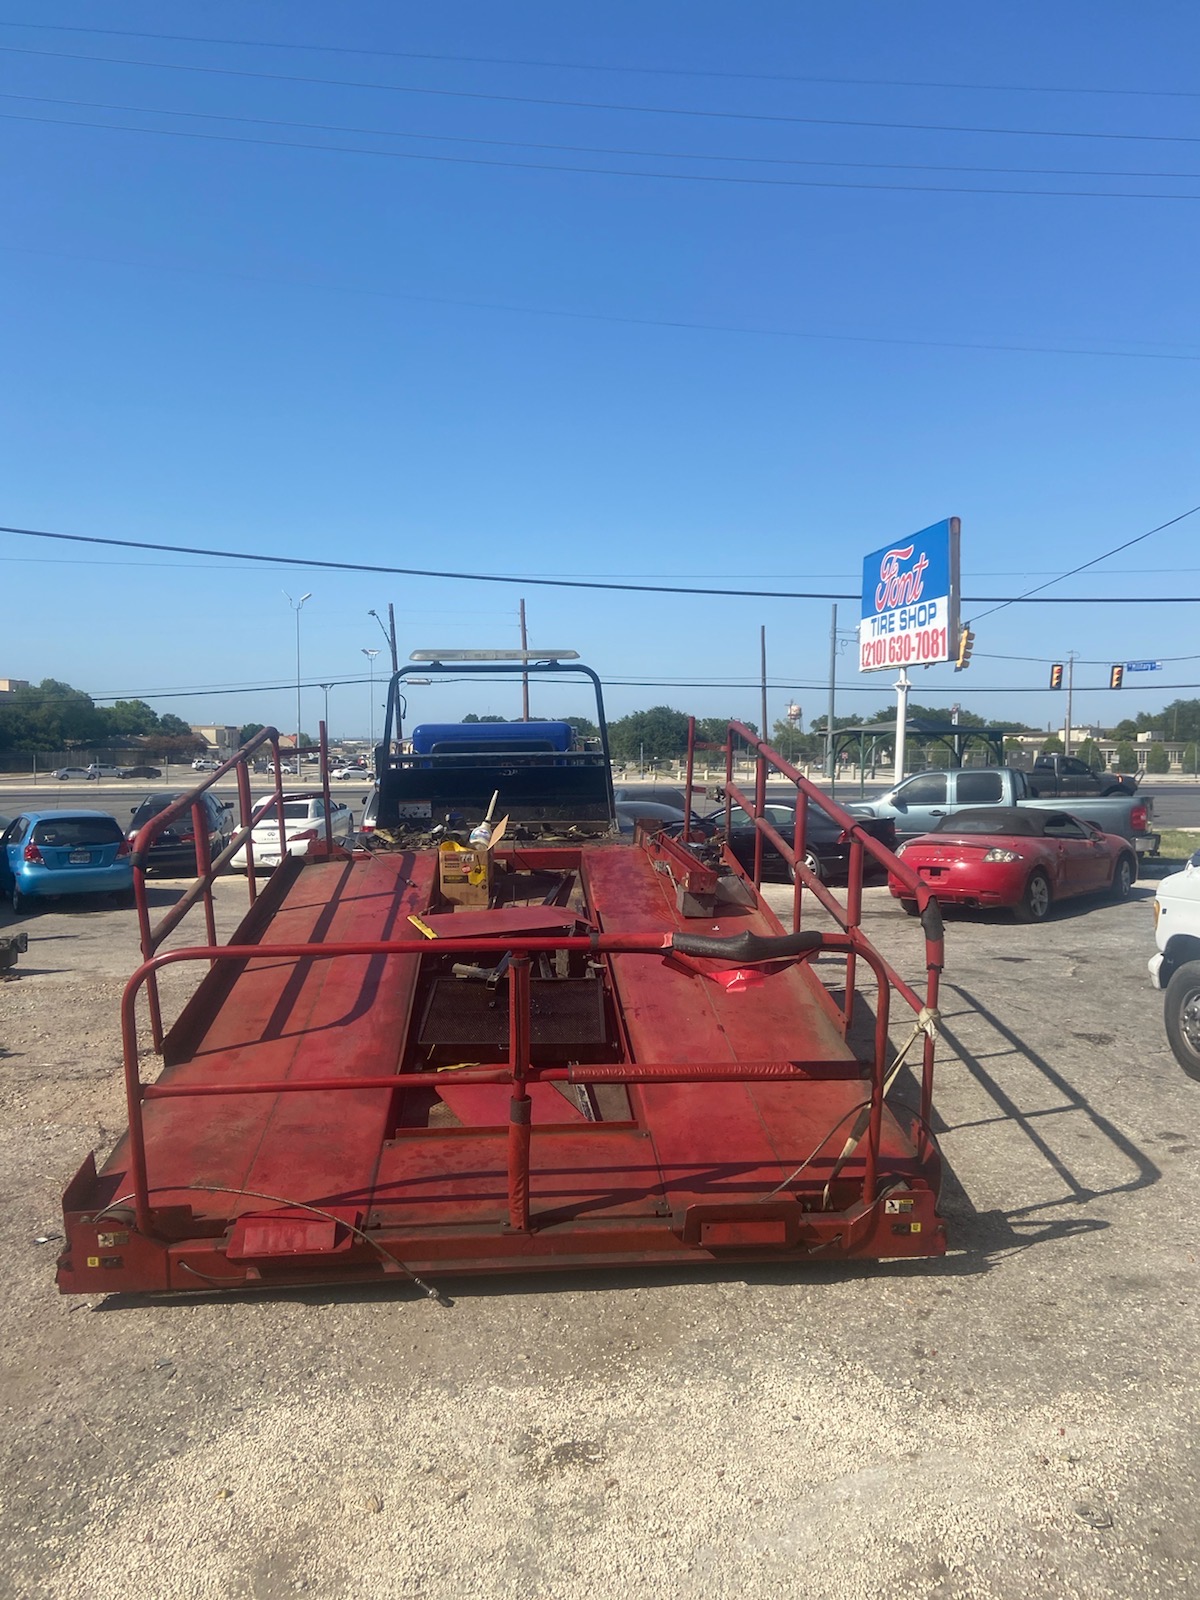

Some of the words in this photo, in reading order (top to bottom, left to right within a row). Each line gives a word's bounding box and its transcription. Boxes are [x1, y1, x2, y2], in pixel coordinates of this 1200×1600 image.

[871, 612, 895, 637] TIRE
[900, 602, 937, 631] SHOP
[861, 638, 886, 667] (210)
[889, 627, 946, 663] 630-7081
